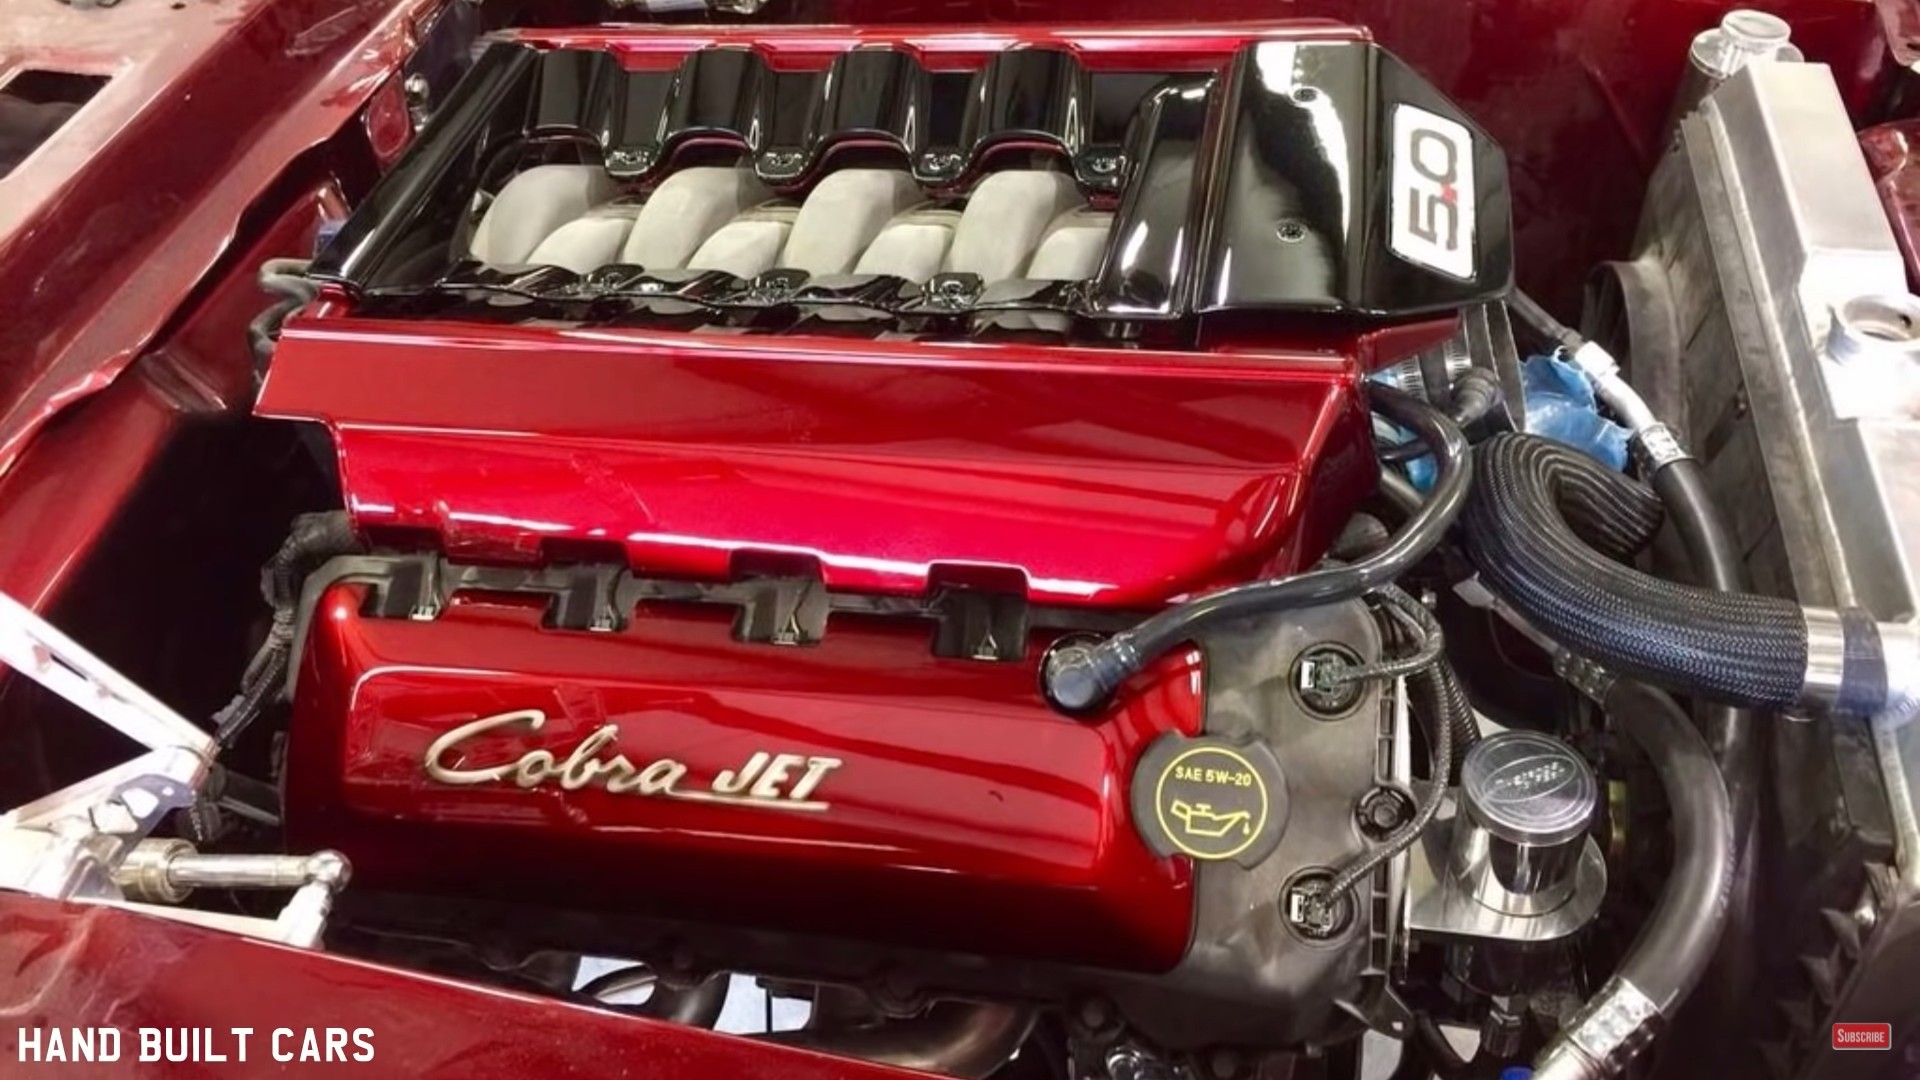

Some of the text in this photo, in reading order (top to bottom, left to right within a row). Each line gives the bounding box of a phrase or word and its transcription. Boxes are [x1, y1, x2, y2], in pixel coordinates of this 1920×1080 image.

[1409, 128, 1458, 251] 5.0
[426, 709, 842, 800] Cobra JET
[1175, 766, 1252, 786] SAE 5W-20
